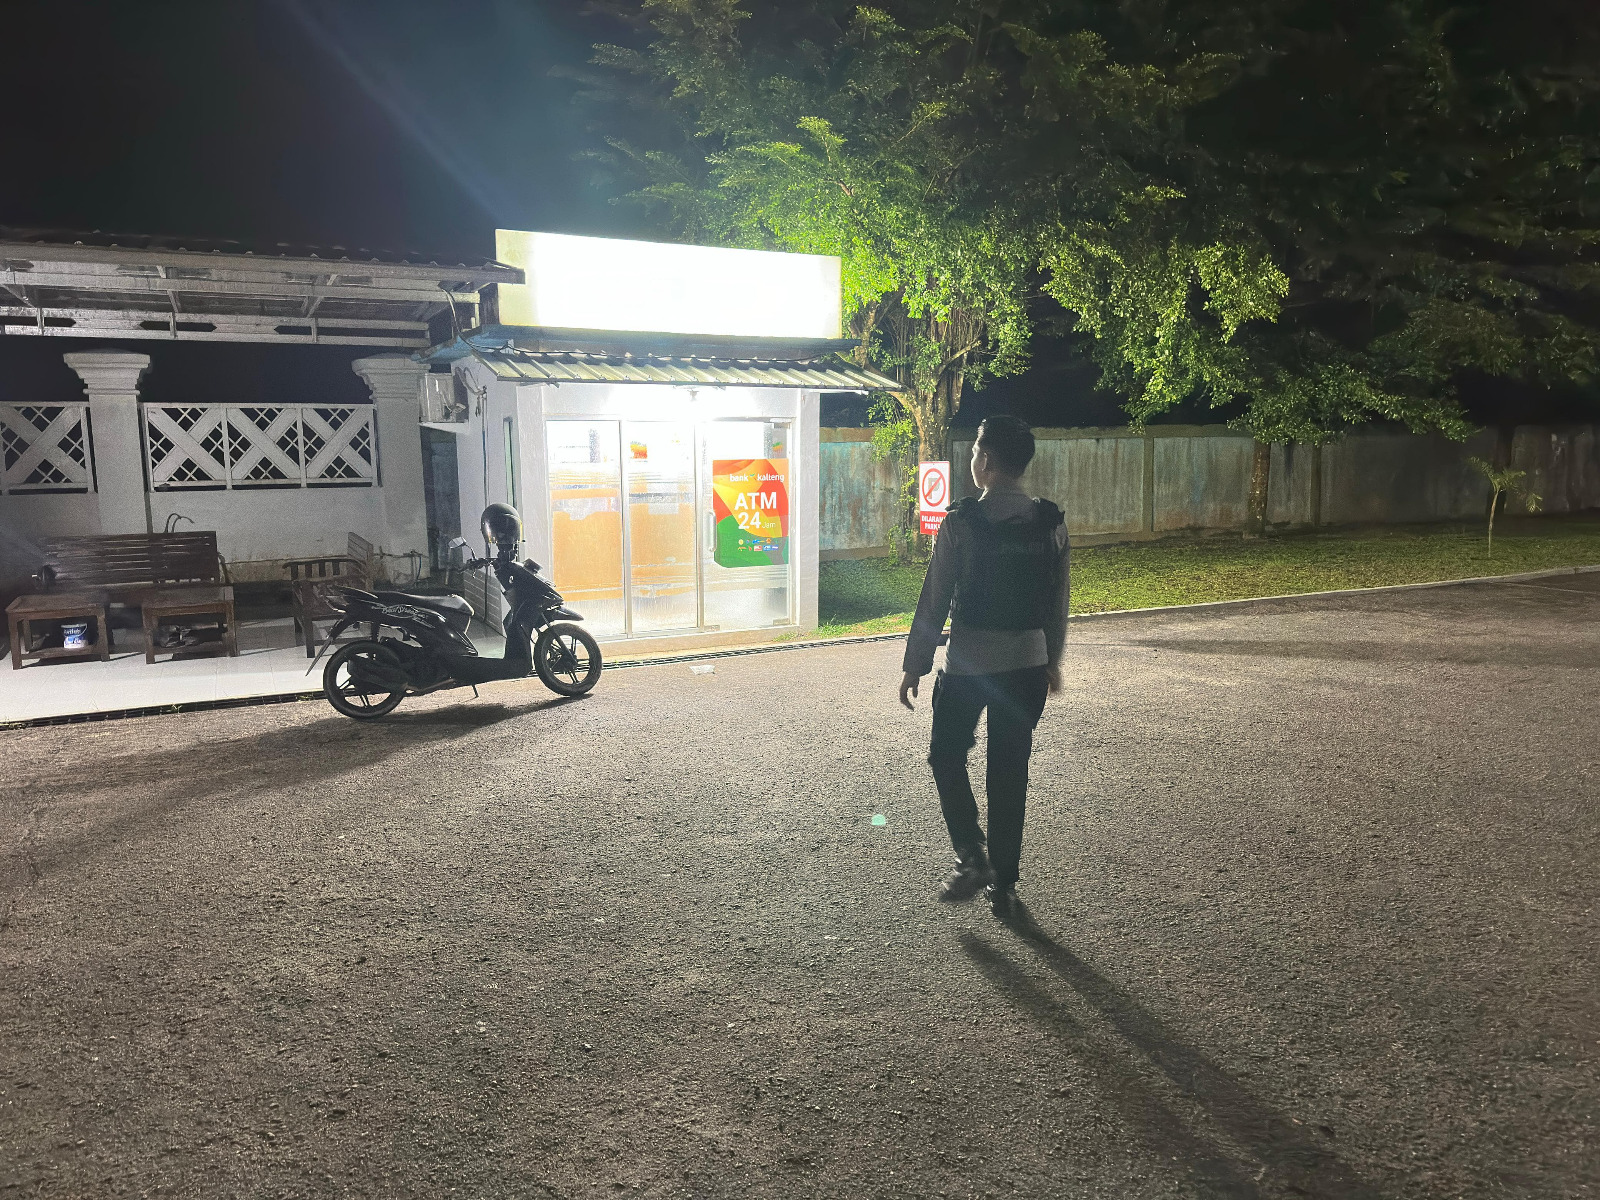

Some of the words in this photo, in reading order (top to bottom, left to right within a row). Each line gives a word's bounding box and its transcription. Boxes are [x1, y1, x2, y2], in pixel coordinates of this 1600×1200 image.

[730, 473, 749, 482] bank
[757, 473, 785, 483] kalteng
[734, 491, 777, 511] ATM
[738, 511, 761, 530] 24
[921, 515, 946, 523] DILARAN
